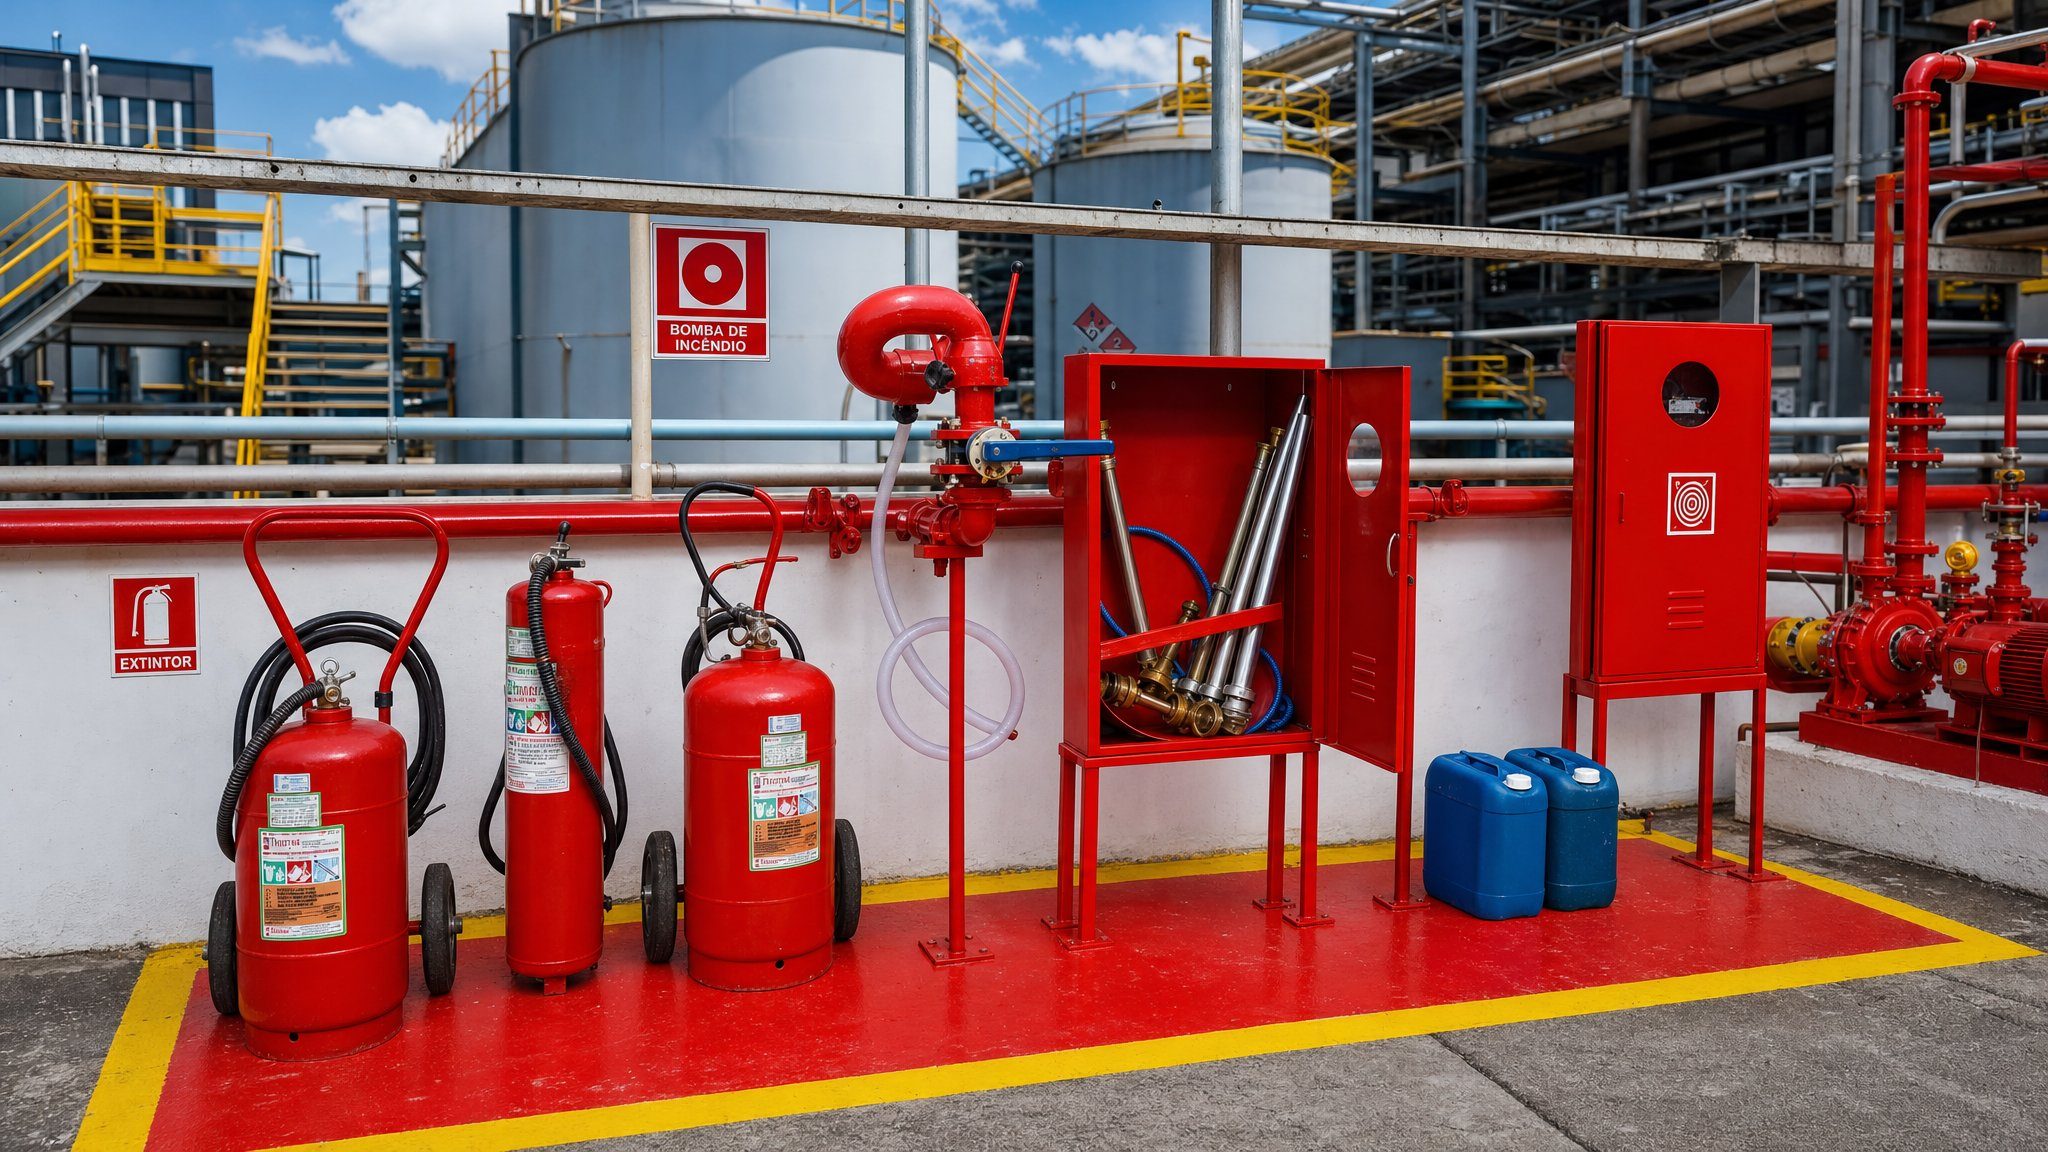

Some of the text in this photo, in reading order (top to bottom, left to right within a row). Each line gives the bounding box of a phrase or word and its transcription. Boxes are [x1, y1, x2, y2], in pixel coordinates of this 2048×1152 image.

[670, 324, 748, 337] BOMBA DE
[675, 338, 746, 352] INCÊNDIO
[120, 656, 192, 670] EXTINTOR
